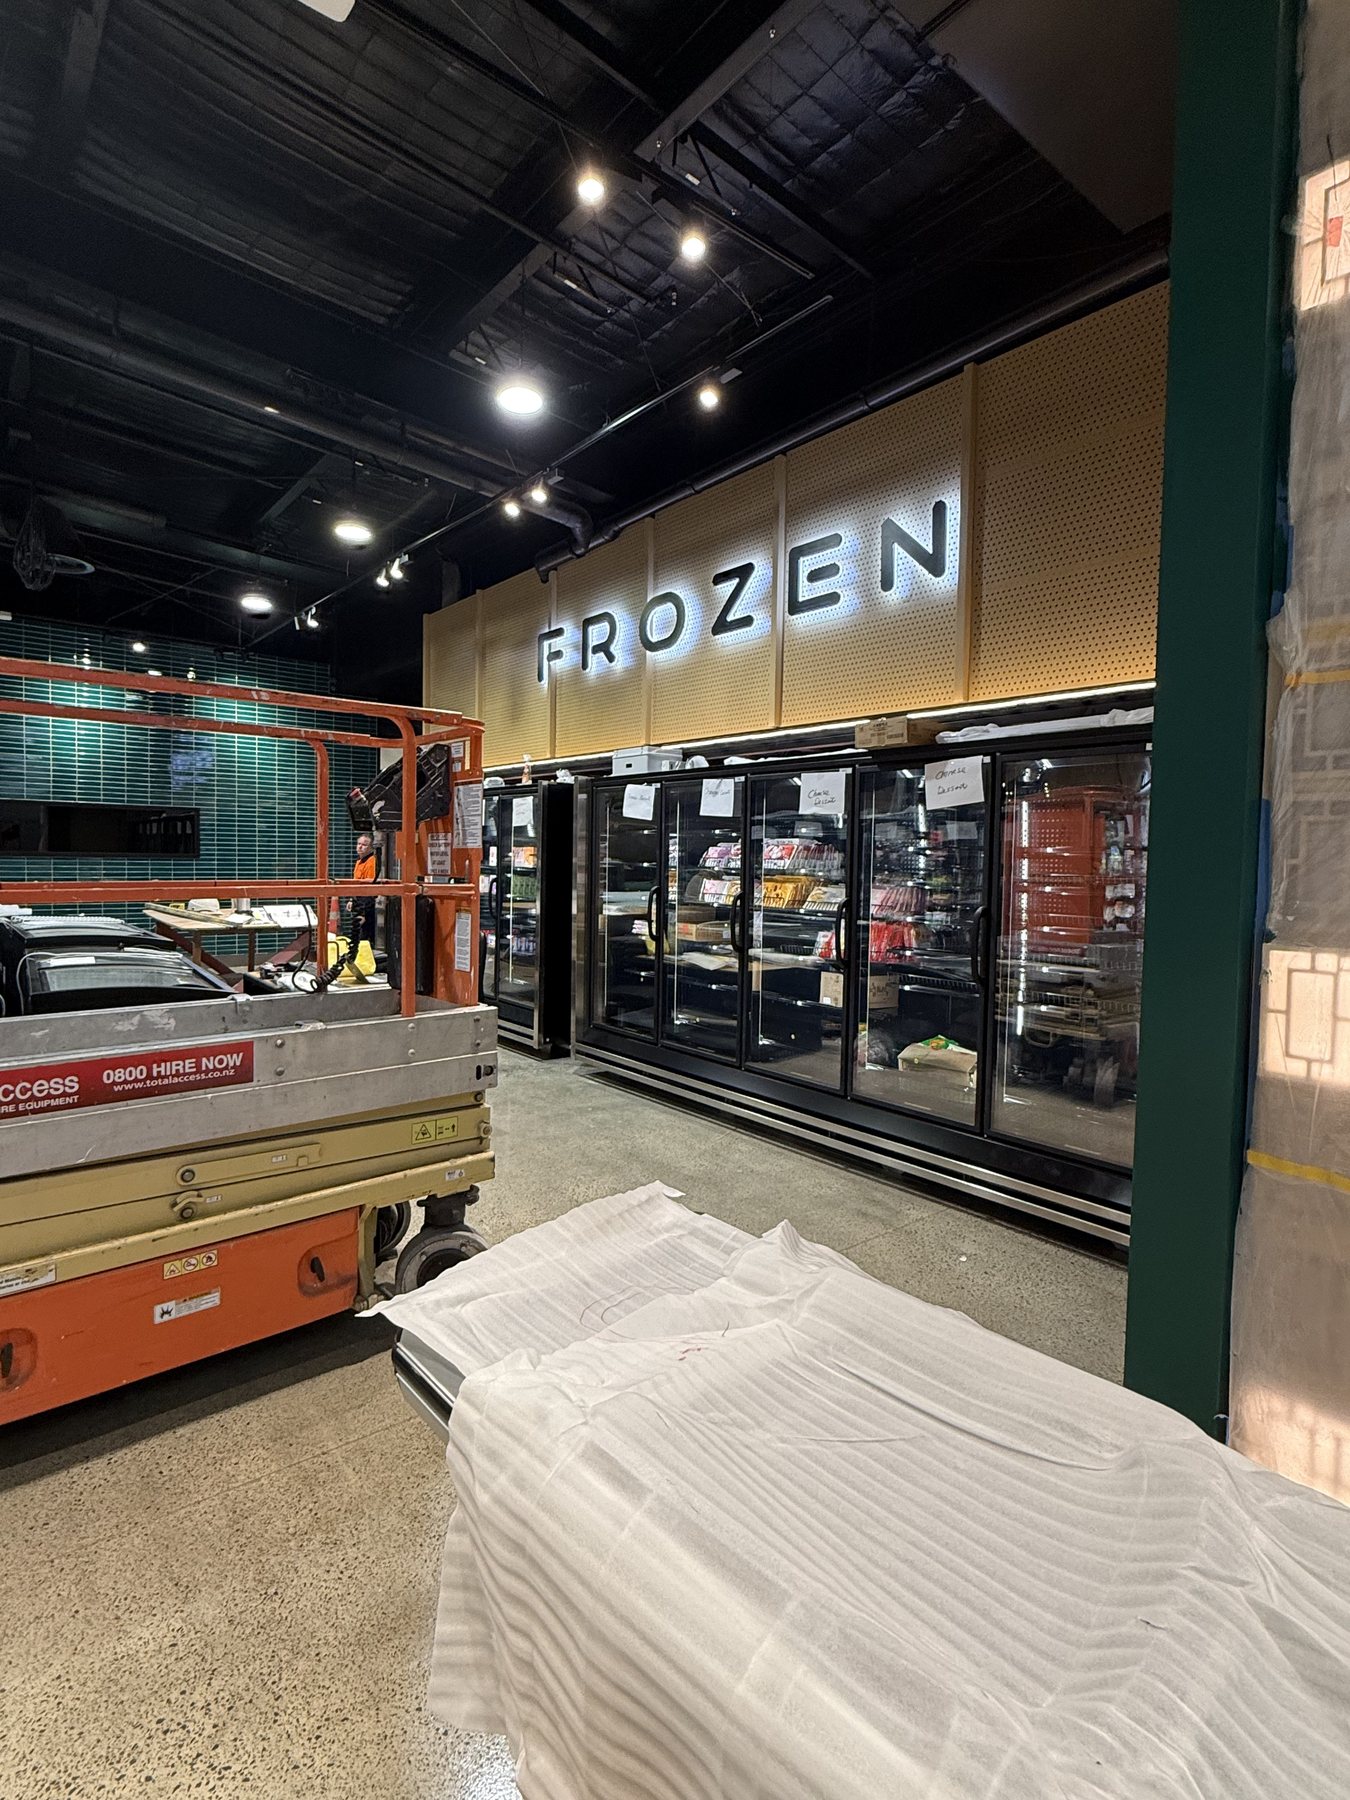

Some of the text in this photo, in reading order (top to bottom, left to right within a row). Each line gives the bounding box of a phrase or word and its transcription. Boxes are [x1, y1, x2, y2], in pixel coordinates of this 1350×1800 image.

[537, 499, 948, 683] FROZEN
[102, 1052, 244, 1084] 0800 HIRE NOW
[113, 1069, 236, 1092] www.totalaccess.co.nz
[18, 1095, 80, 1111] EQUIPMENT
